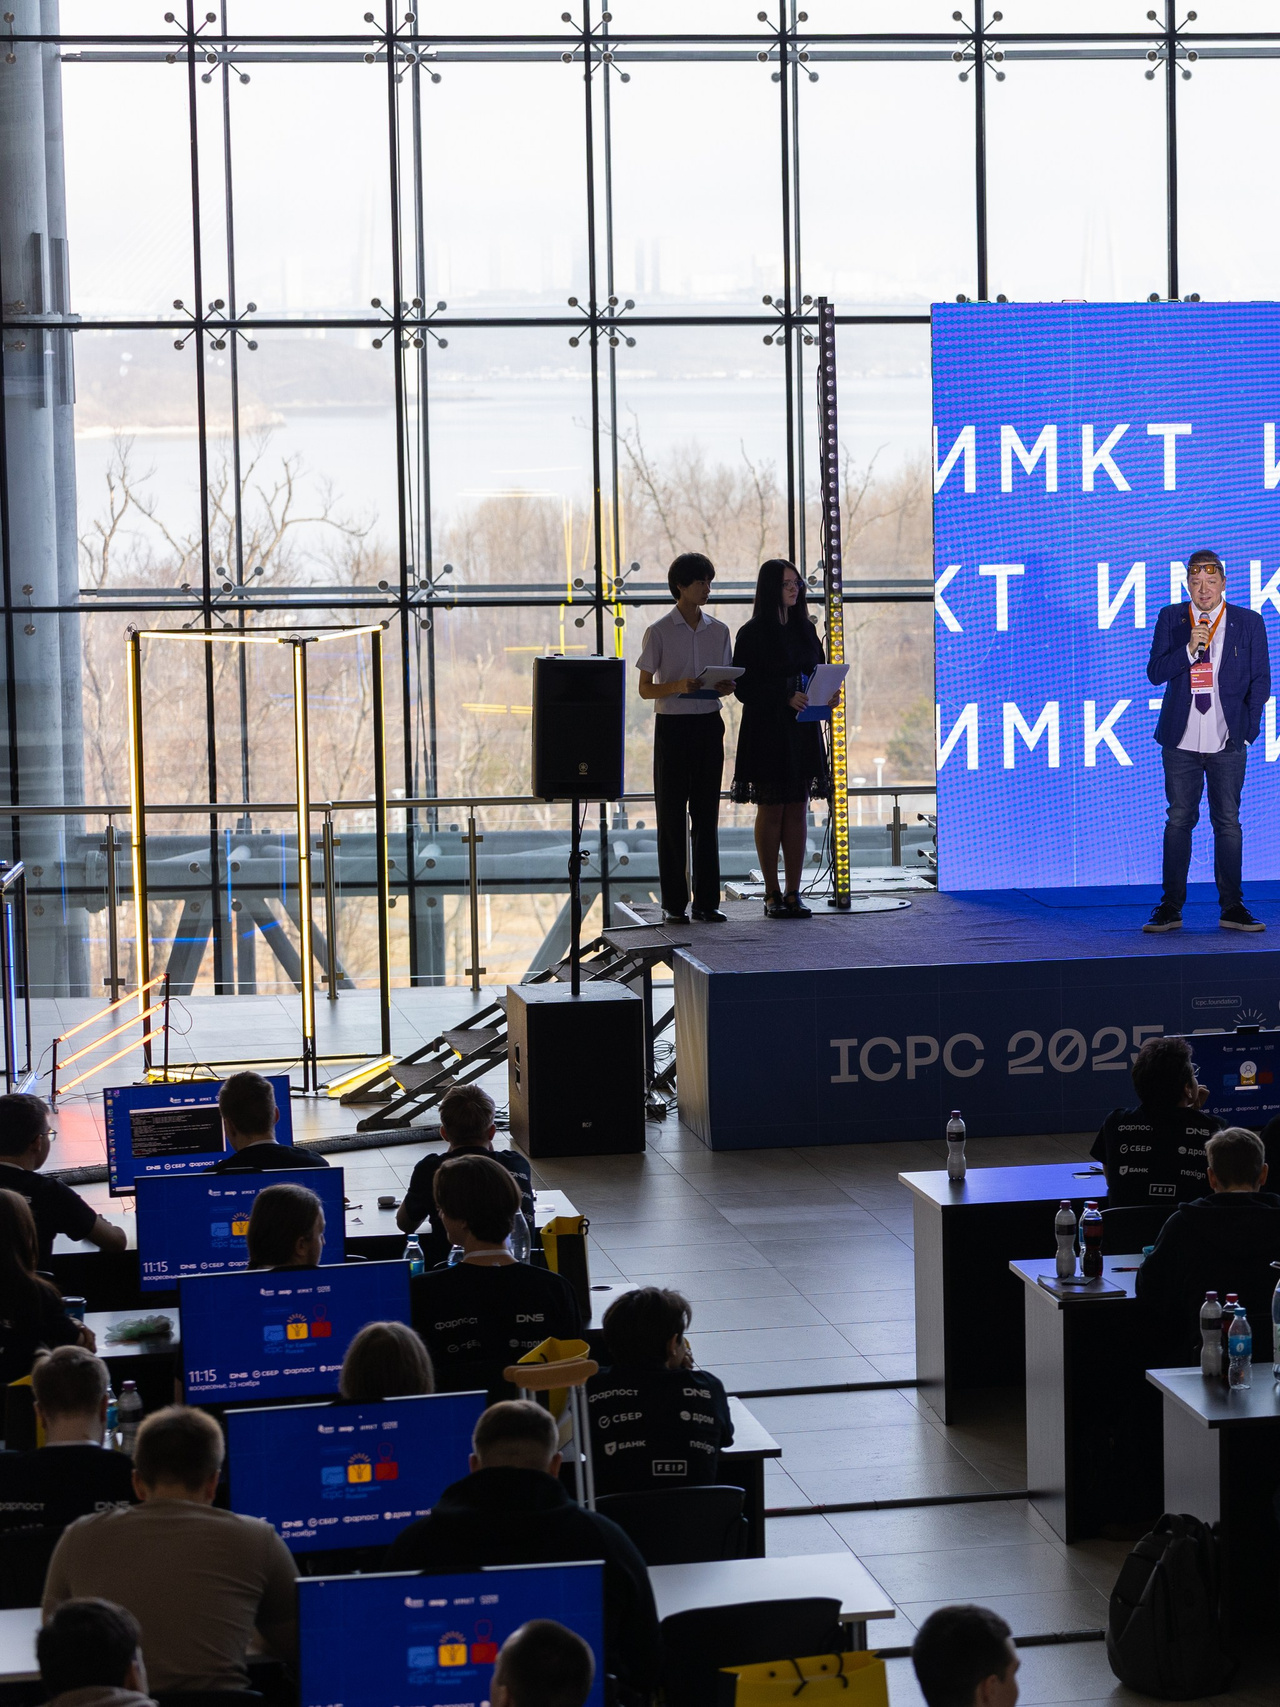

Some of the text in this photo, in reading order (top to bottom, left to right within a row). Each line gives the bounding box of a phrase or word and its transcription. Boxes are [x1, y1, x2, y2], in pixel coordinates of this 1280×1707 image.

[933, 423, 1192, 494] ИМКТ
[936, 698, 1165, 770] ИМК
[1195, 998, 1239, 1007] icpc.foundation
[830, 1032, 985, 1083] ICPC
[1186, 1127, 1210, 1136] DNS
[1180, 1169, 1206, 1180] nexign
[143, 1261, 168, 1273] 11:15
[516, 1313, 545, 1323] DNS
[188, 1369, 217, 1383] 11:15
[229, 1371, 248, 1379] DNS
[261, 1369, 279, 1377] СБЕР
[229, 1381, 236, 1389] 23
[237, 1379, 260, 1388] ноября
[682, 1387, 711, 1399] DNS
[612, 1411, 643, 1423] СБЕР
[618, 1440, 646, 1450] БАНК
[656, 1464, 684, 1472] FEIP
[282, 1520, 304, 1529] DNS
[318, 1517, 339, 1526] СБЕР
